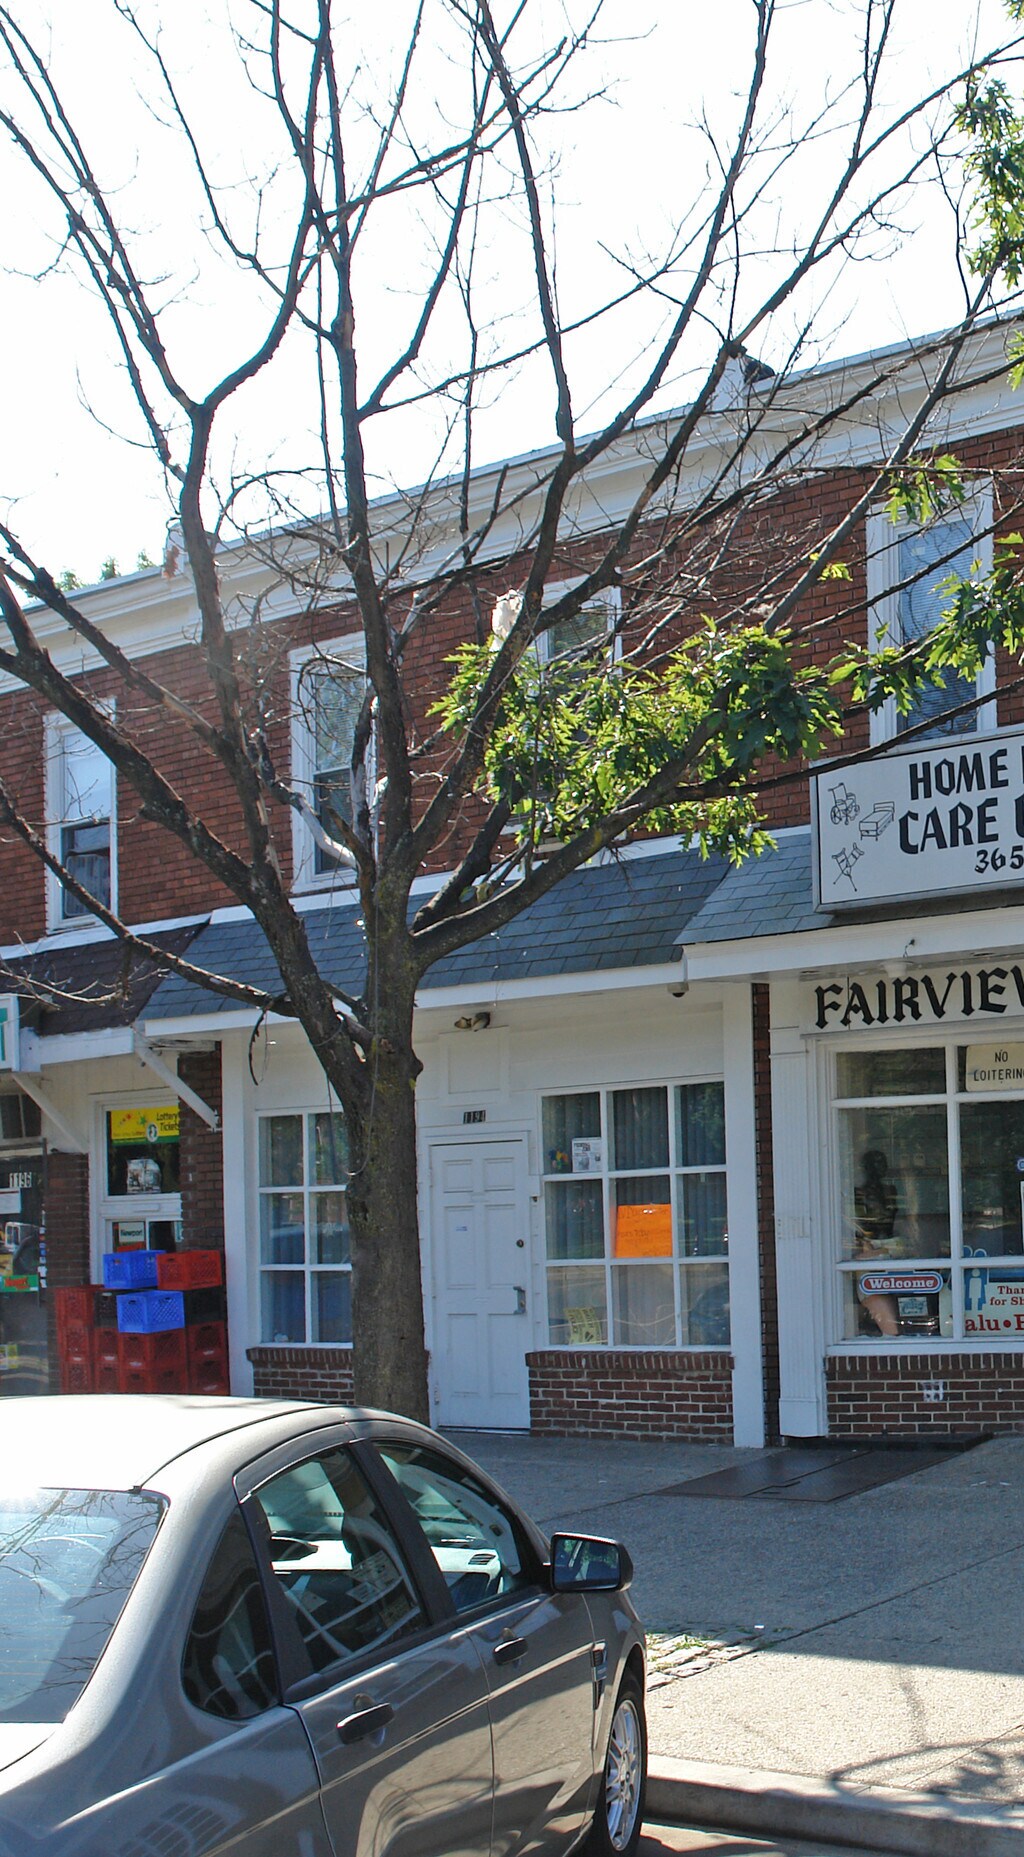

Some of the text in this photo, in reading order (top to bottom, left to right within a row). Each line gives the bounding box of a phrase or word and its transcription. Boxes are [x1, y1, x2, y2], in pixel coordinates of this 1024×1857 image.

[909, 748, 1009, 801] HOME
[899, 797, 999, 855] CARE
[994, 1051, 1008, 1063] NO
[156, 1112, 178, 1122] Lottery
[9, 1172, 32, 1188] 1196
[867, 1277, 935, 1289] Welcome
[989, 1296, 1009, 1306] for
